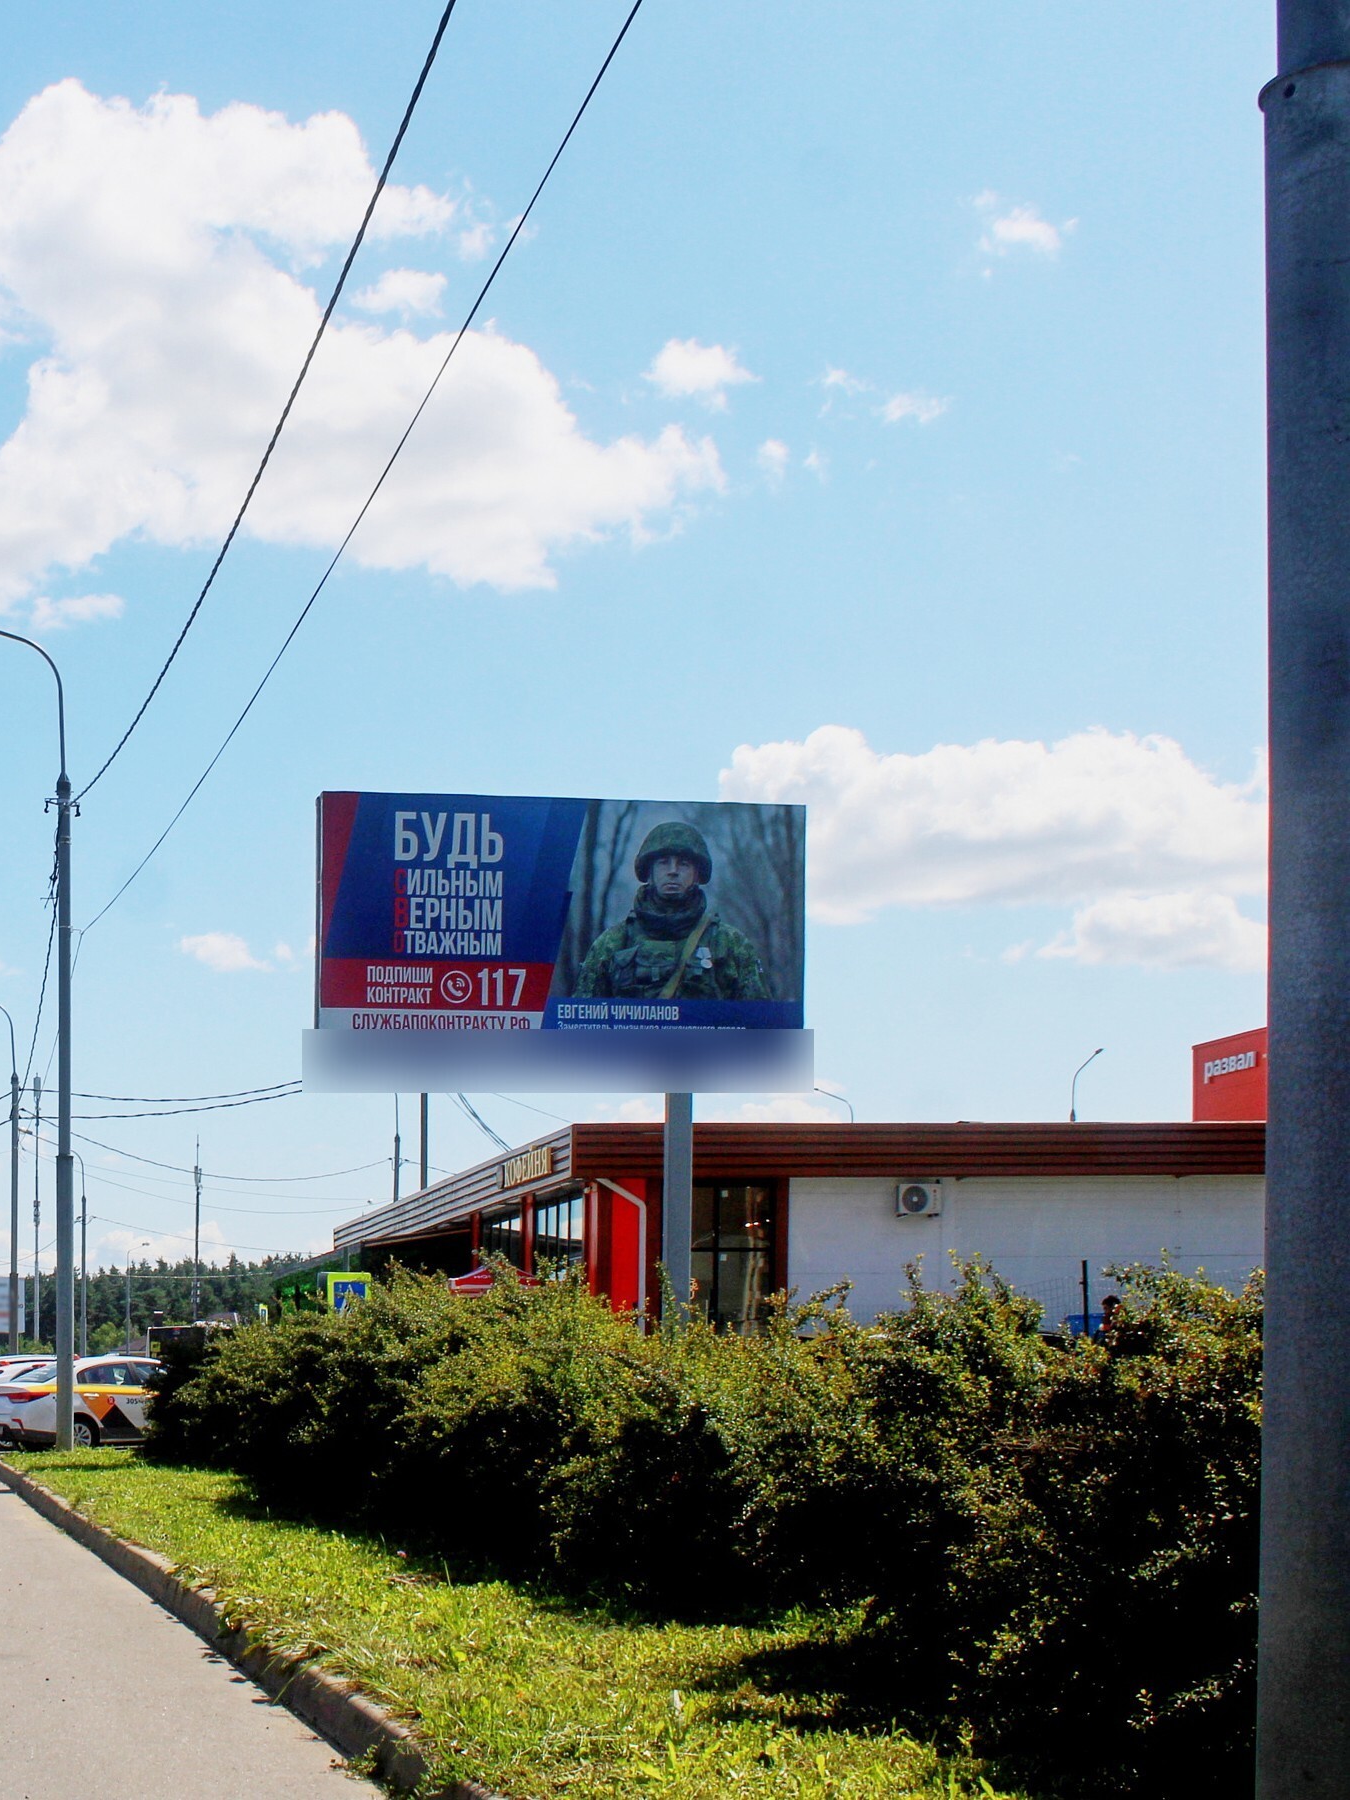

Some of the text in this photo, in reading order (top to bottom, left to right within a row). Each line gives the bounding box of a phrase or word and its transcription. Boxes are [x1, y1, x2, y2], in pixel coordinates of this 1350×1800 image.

[394, 811, 504, 869] БУДЬ
[394, 868, 503, 897] СИЛЬНЫМ
[394, 897, 503, 931] ВЕРНЫМ
[393, 930, 502, 956] ОТВАЖНЫМ
[366, 965, 434, 985] ПОДПИШИ
[477, 968, 527, 1007] 117
[366, 986, 433, 1005] КОНТРАКТ
[557, 1002, 680, 1021] ЕВГЕНИЙ ЧИЧИЛАНОВ
[1203, 1050, 1257, 1085] развал
[504, 1145, 548, 1189] КОФЕЙНЯ
